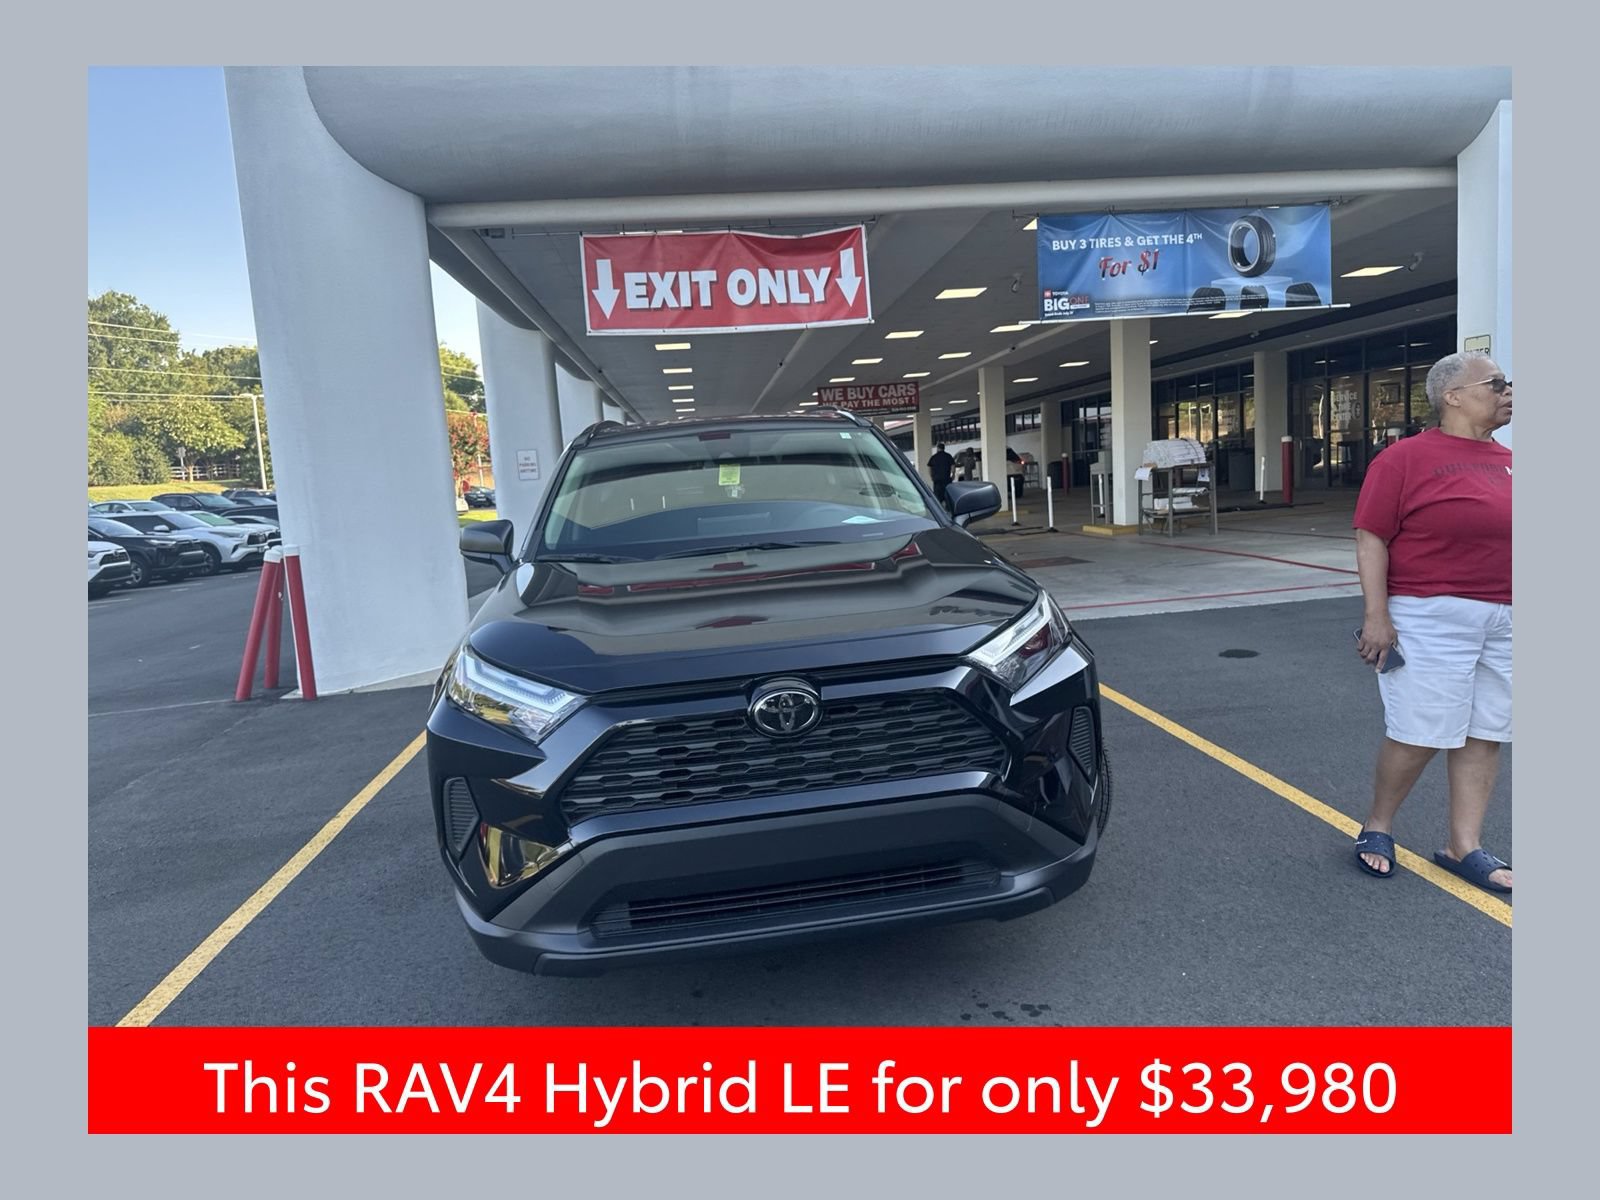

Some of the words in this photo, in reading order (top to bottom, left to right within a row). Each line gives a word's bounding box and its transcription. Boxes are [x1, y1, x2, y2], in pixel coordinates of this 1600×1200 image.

[1052, 239, 1077, 250] BUY
[1079, 238, 1087, 249] 3
[1089, 236, 1122, 249] TIRES
[1124, 236, 1134, 247] &
[1136, 235, 1160, 246] GET
[1161, 234, 1184, 245] THE
[1185, 232, 1203, 244] 4TH
[1099, 255, 1132, 280] For
[1137, 248, 1160, 276] $1
[624, 270, 717, 309] EXIT
[726, 266, 832, 306] ONLY
[1044, 297, 1070, 311] BIG
[821, 389, 843, 401] WE
[846, 386, 875, 400] BUY
[878, 383, 917, 398] CARS
[840, 400, 859, 408] PAY
[861, 399, 880, 407] THE
[882, 397, 910, 406] MOST
